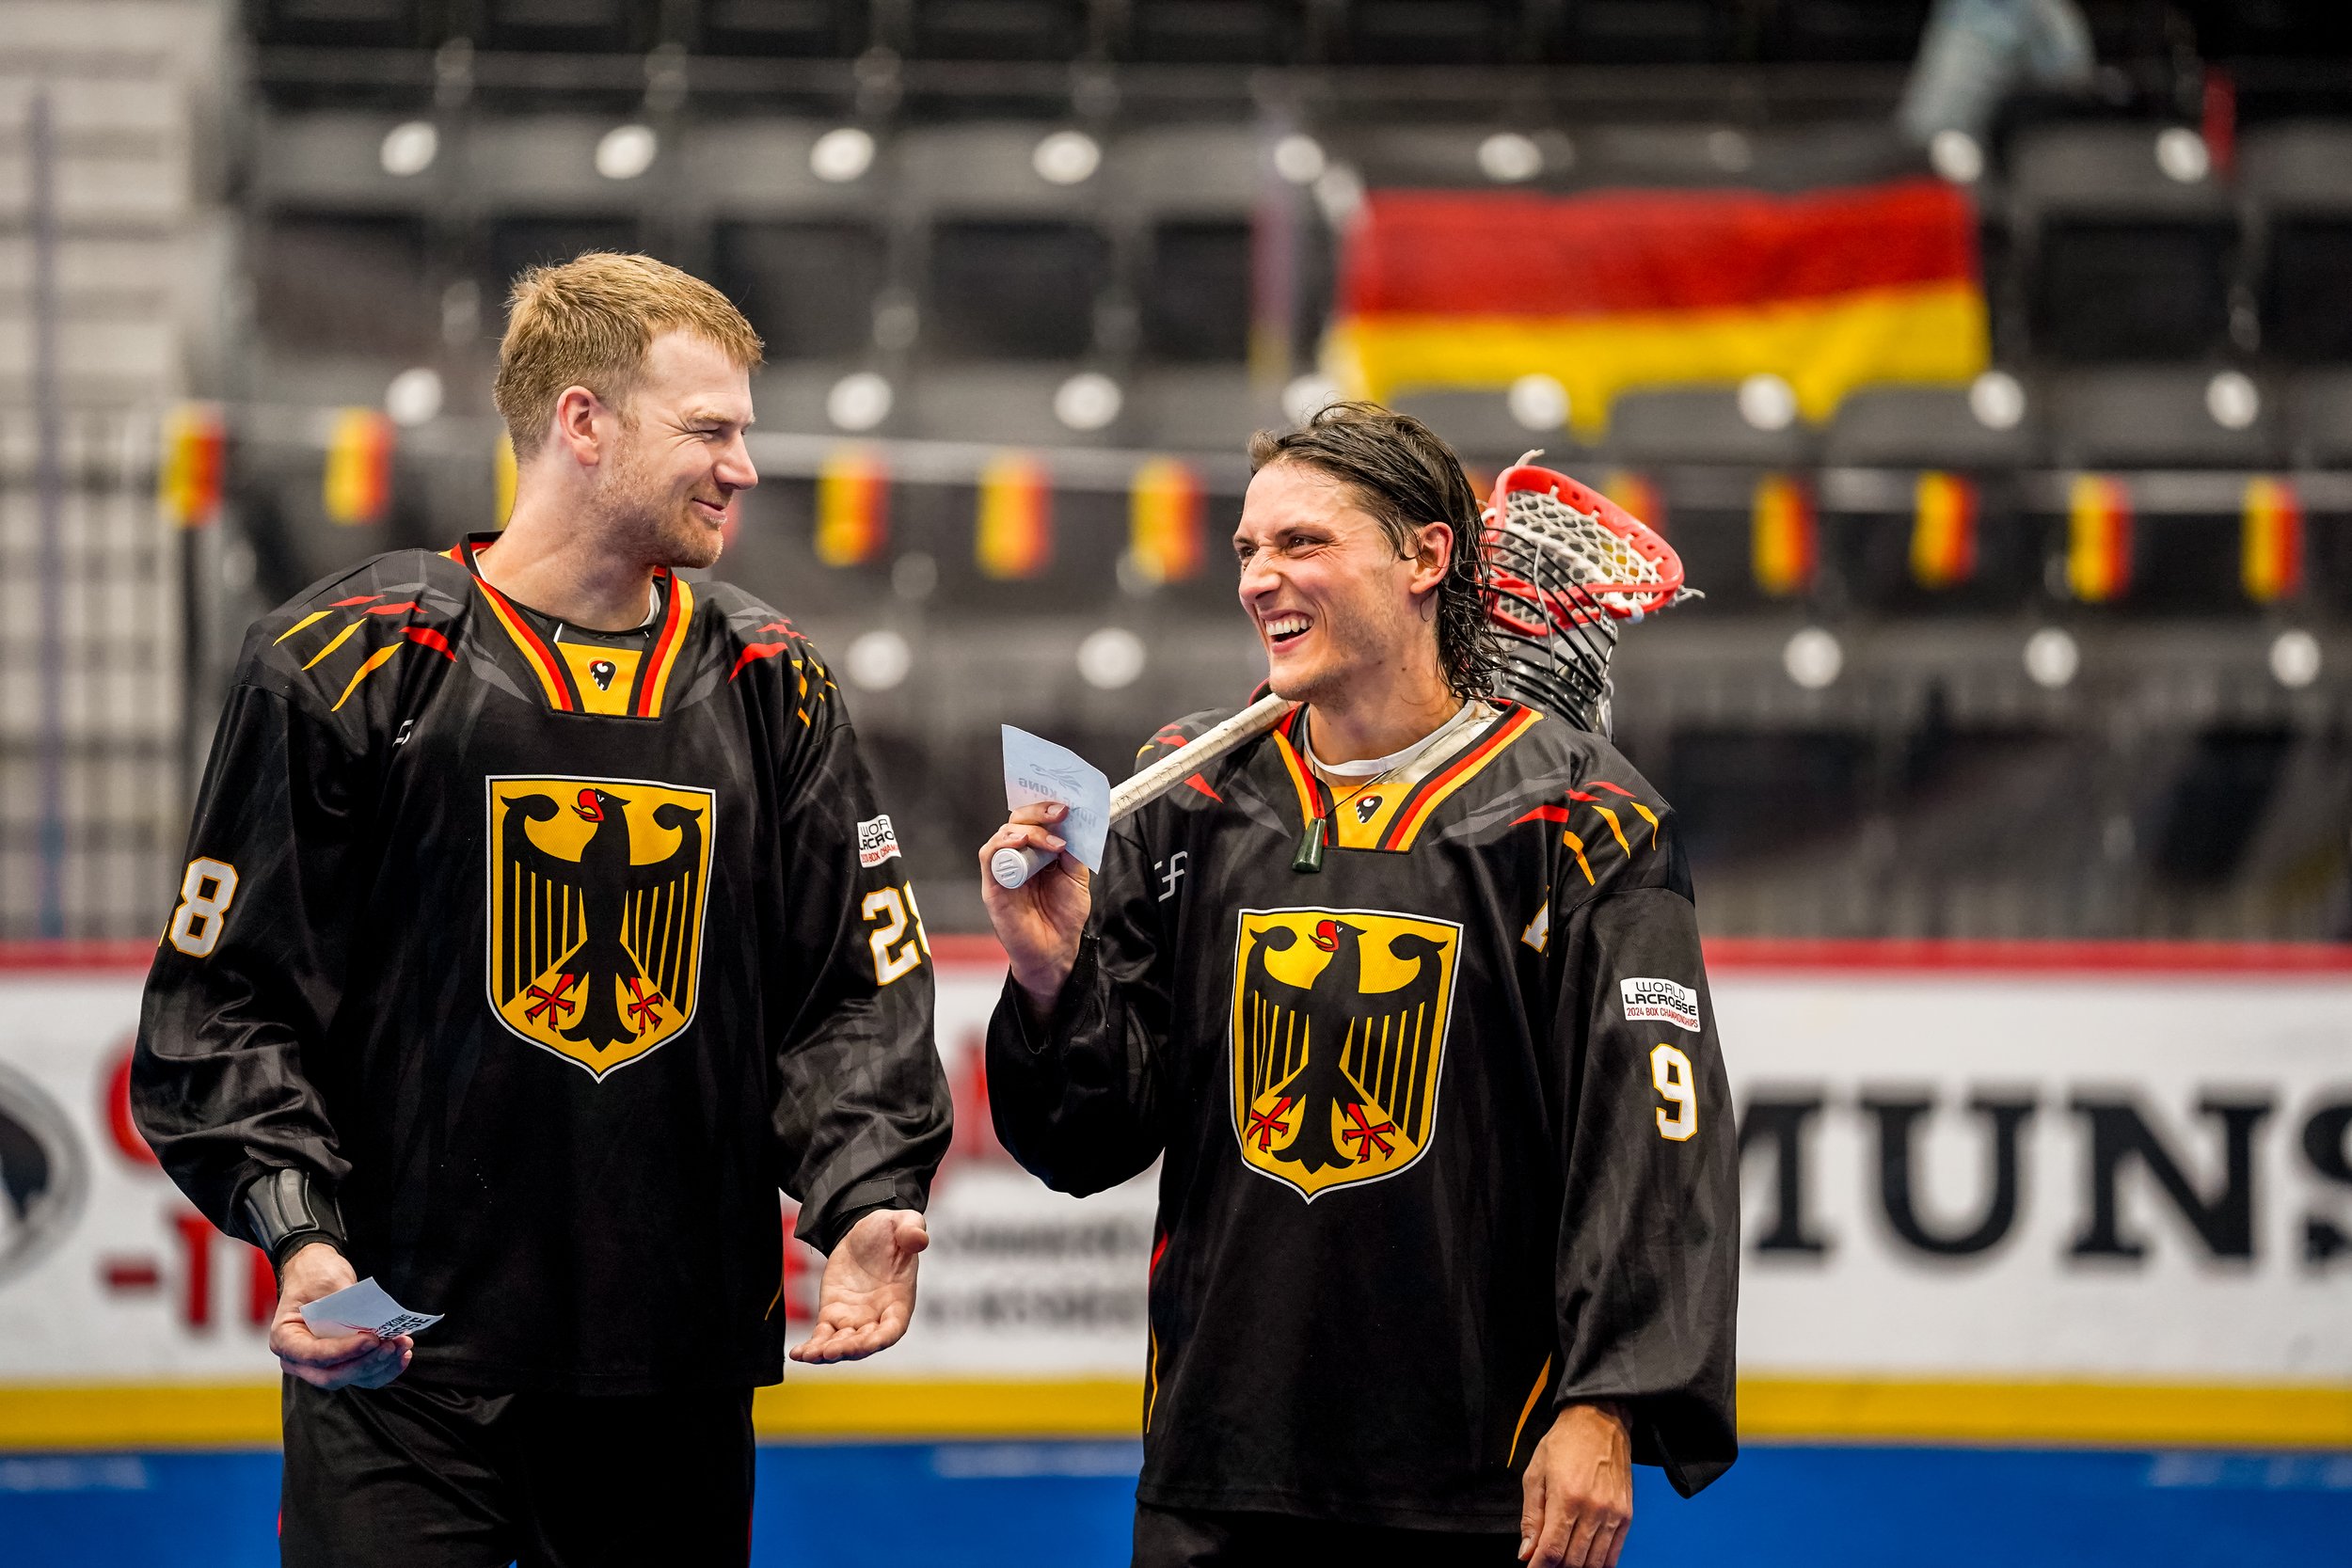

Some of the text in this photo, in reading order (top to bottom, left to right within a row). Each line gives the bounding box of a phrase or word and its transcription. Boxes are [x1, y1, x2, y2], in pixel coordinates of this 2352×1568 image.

[158, 856, 240, 958] 8
[1635, 981, 1686, 1001] WORLD
[1624, 993, 1697, 1016] LACROSSE
[1626, 1007, 1645, 1017] 2024
[1645, 1007, 1660, 1017] BOX
[1649, 1042, 1698, 1142] 9
